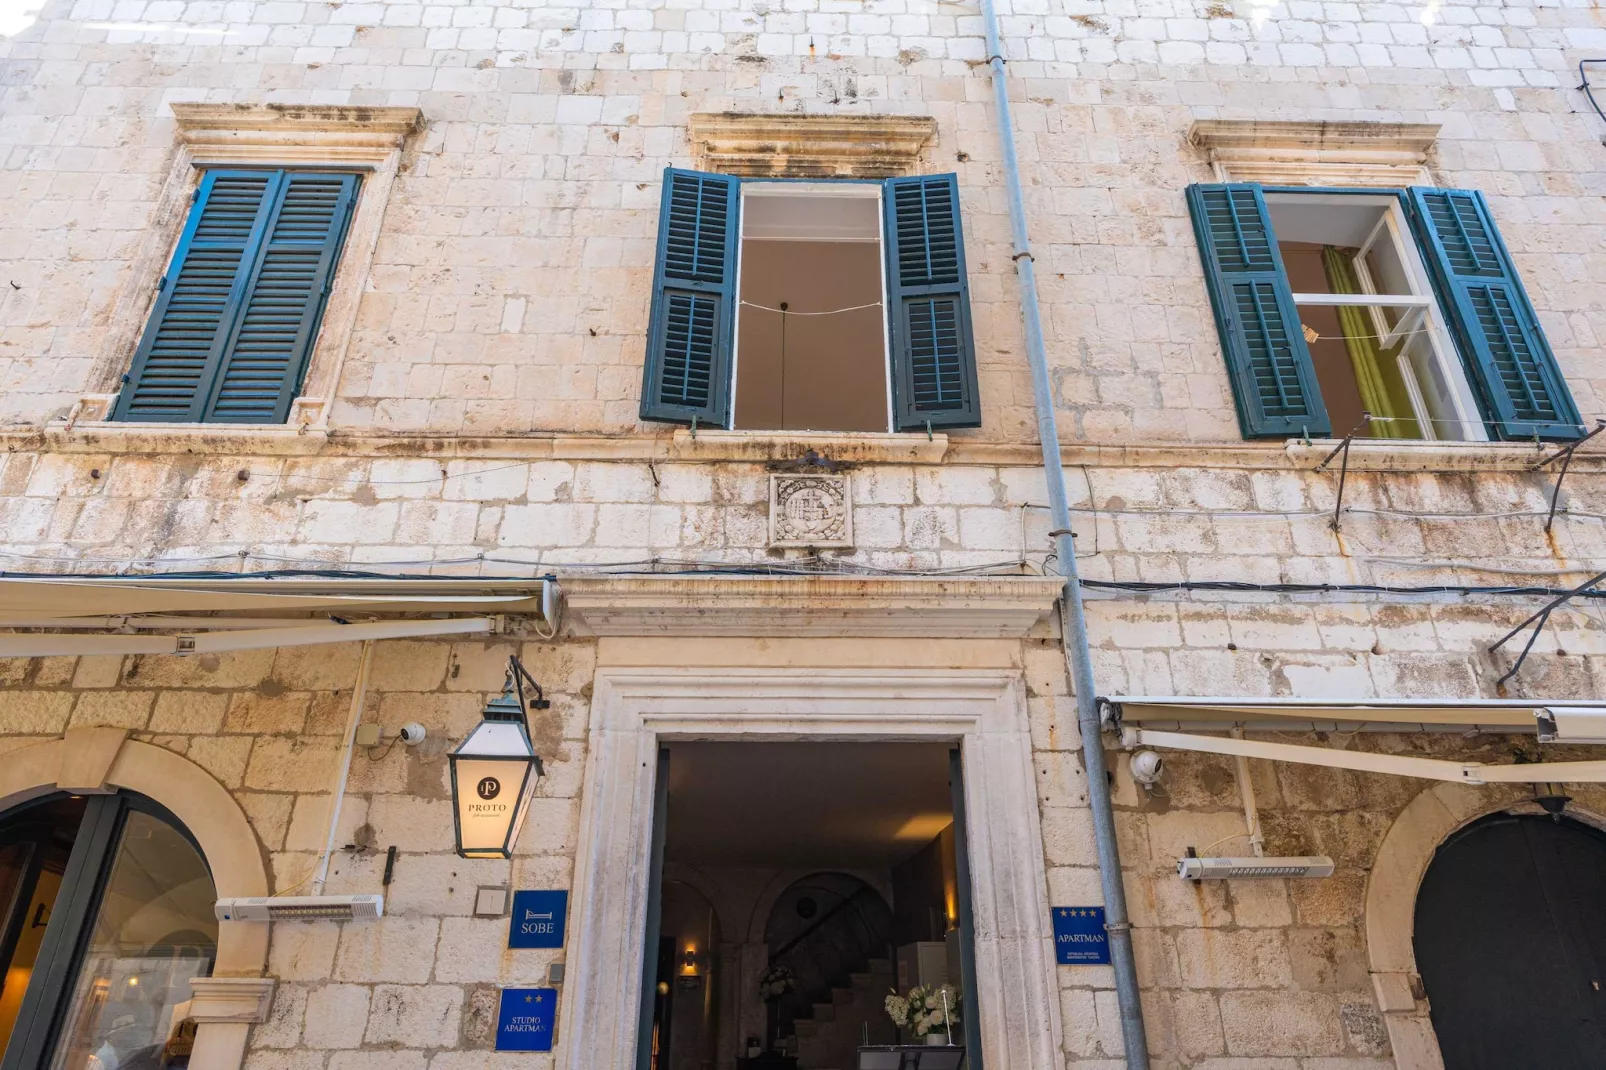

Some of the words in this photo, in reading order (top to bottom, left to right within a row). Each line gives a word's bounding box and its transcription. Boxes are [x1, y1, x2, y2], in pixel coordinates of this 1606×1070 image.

[468, 804, 507, 812] PROTO
[521, 922, 554, 934] SOBE
[1058, 934, 1104, 943] APARTMAN
[511, 1016, 541, 1025] STUDIO
